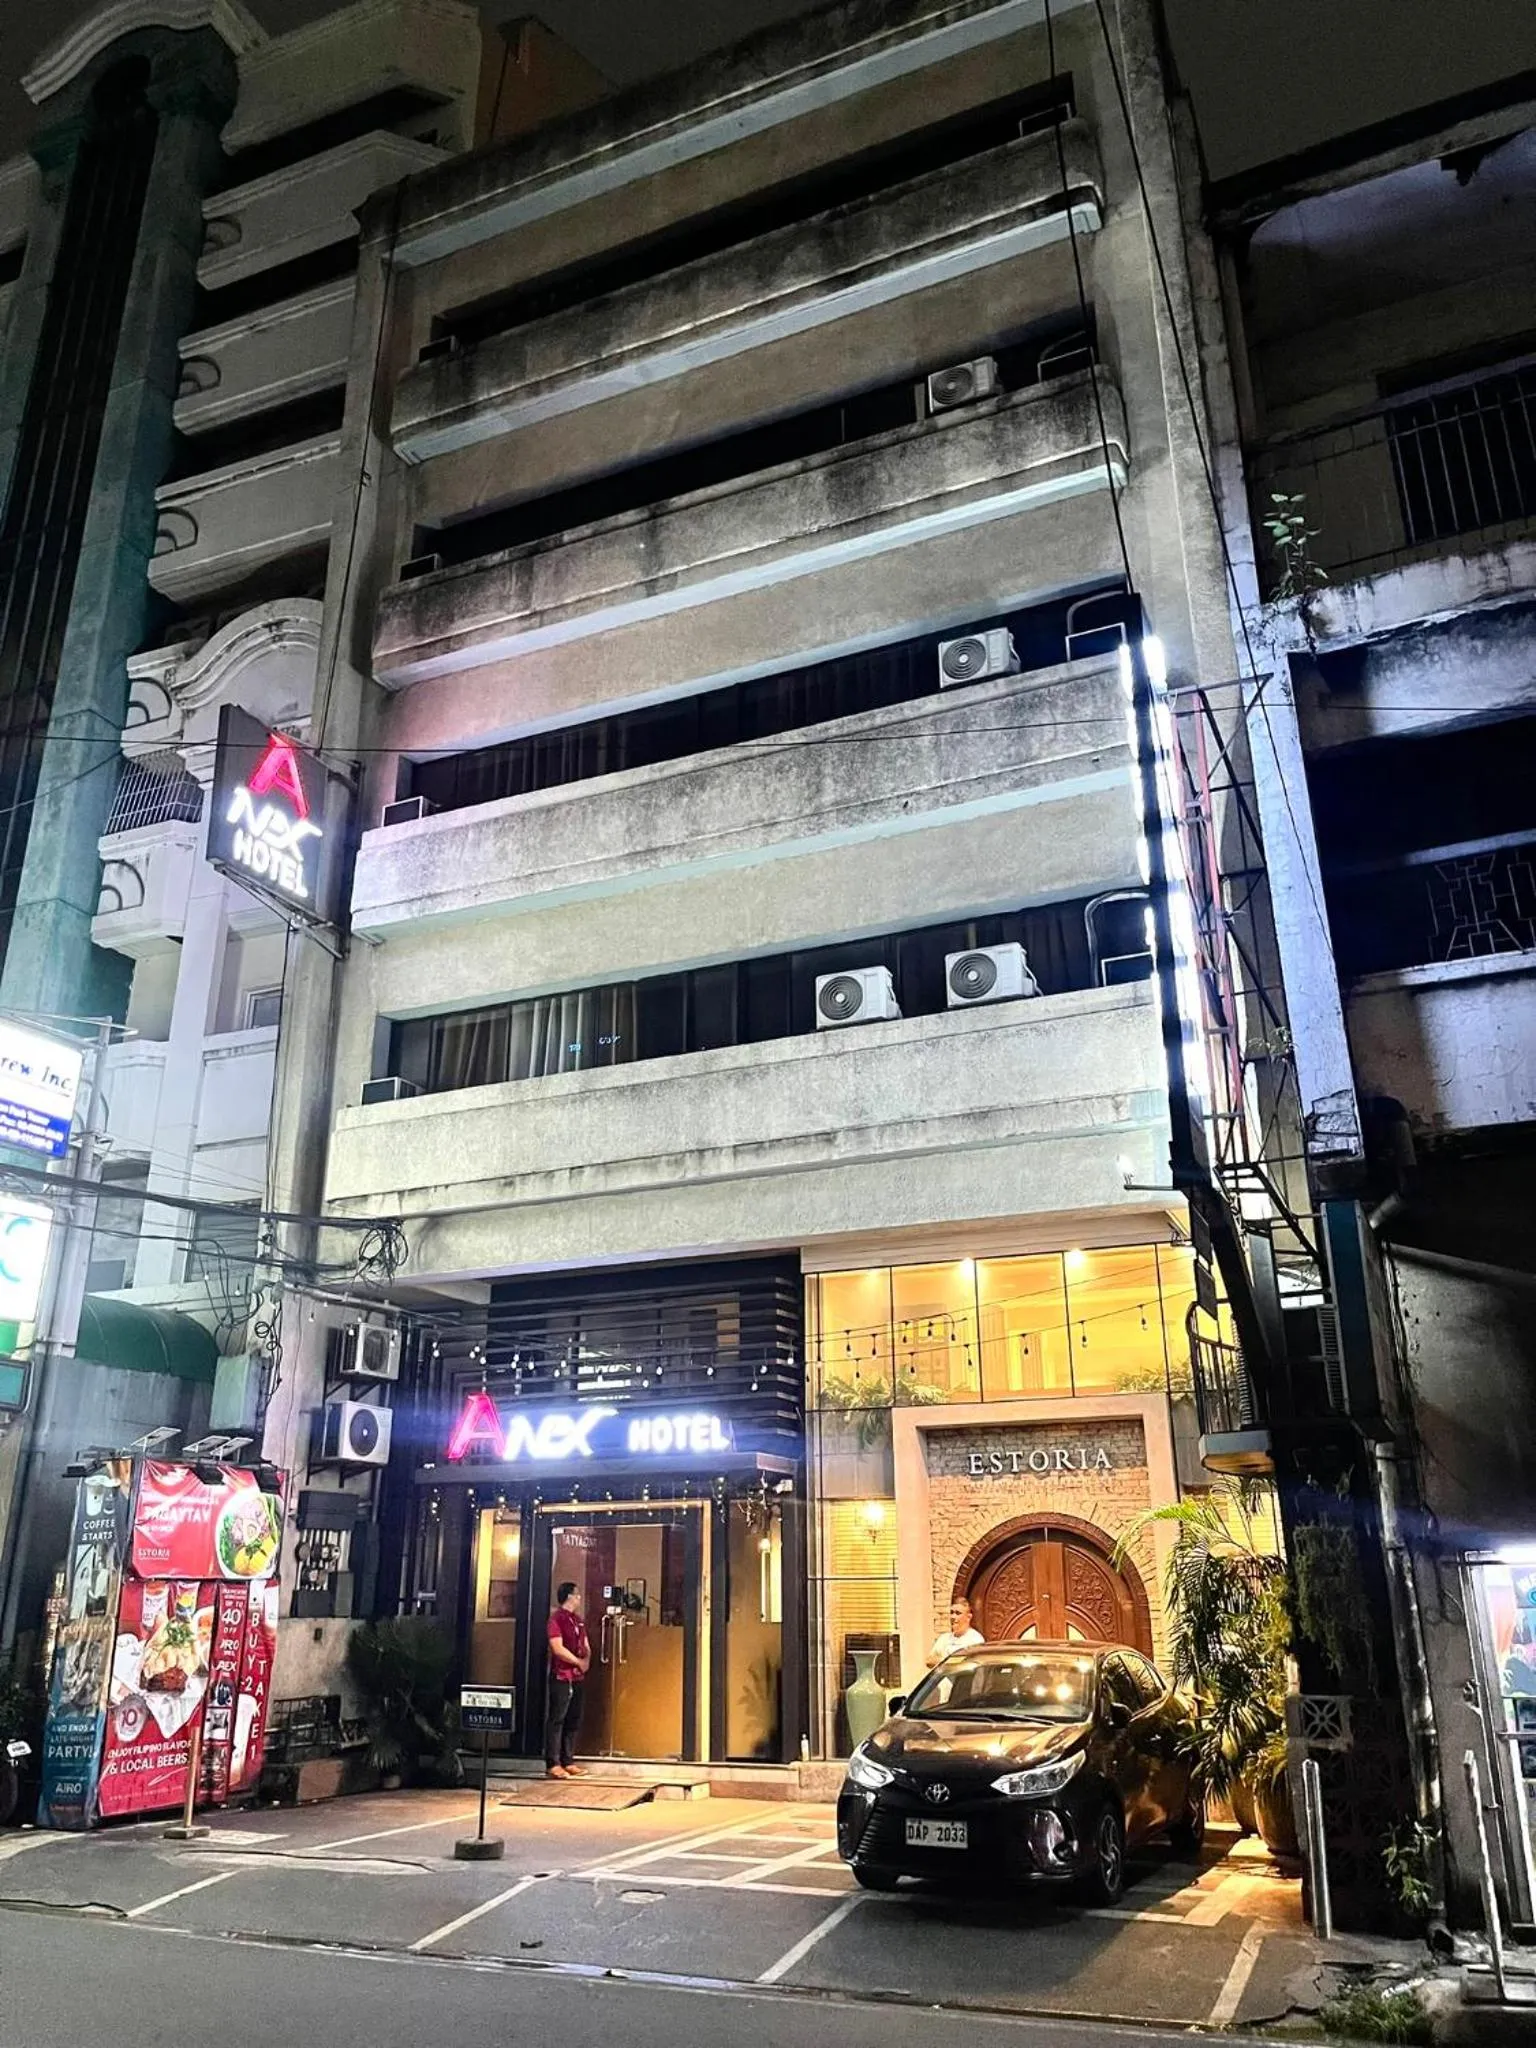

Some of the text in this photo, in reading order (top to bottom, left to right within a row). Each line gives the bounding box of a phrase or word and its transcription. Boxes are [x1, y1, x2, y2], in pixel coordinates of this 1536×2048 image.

[233, 828, 308, 897] HOTEL
[628, 1415, 731, 1453] HOTEL
[968, 1448, 1113, 1474] ESTORIA
[83, 1519, 115, 1530] COFFEE
[82, 1531, 113, 1541] STARTS
[222, 1608, 241, 1625] 40
[48, 1745, 93, 1758] PARTY!
[109, 1753, 188, 1774] & LOCAL BEERS
[55, 1783, 82, 1794] AIRO
[936, 1826, 965, 1842] 2033
